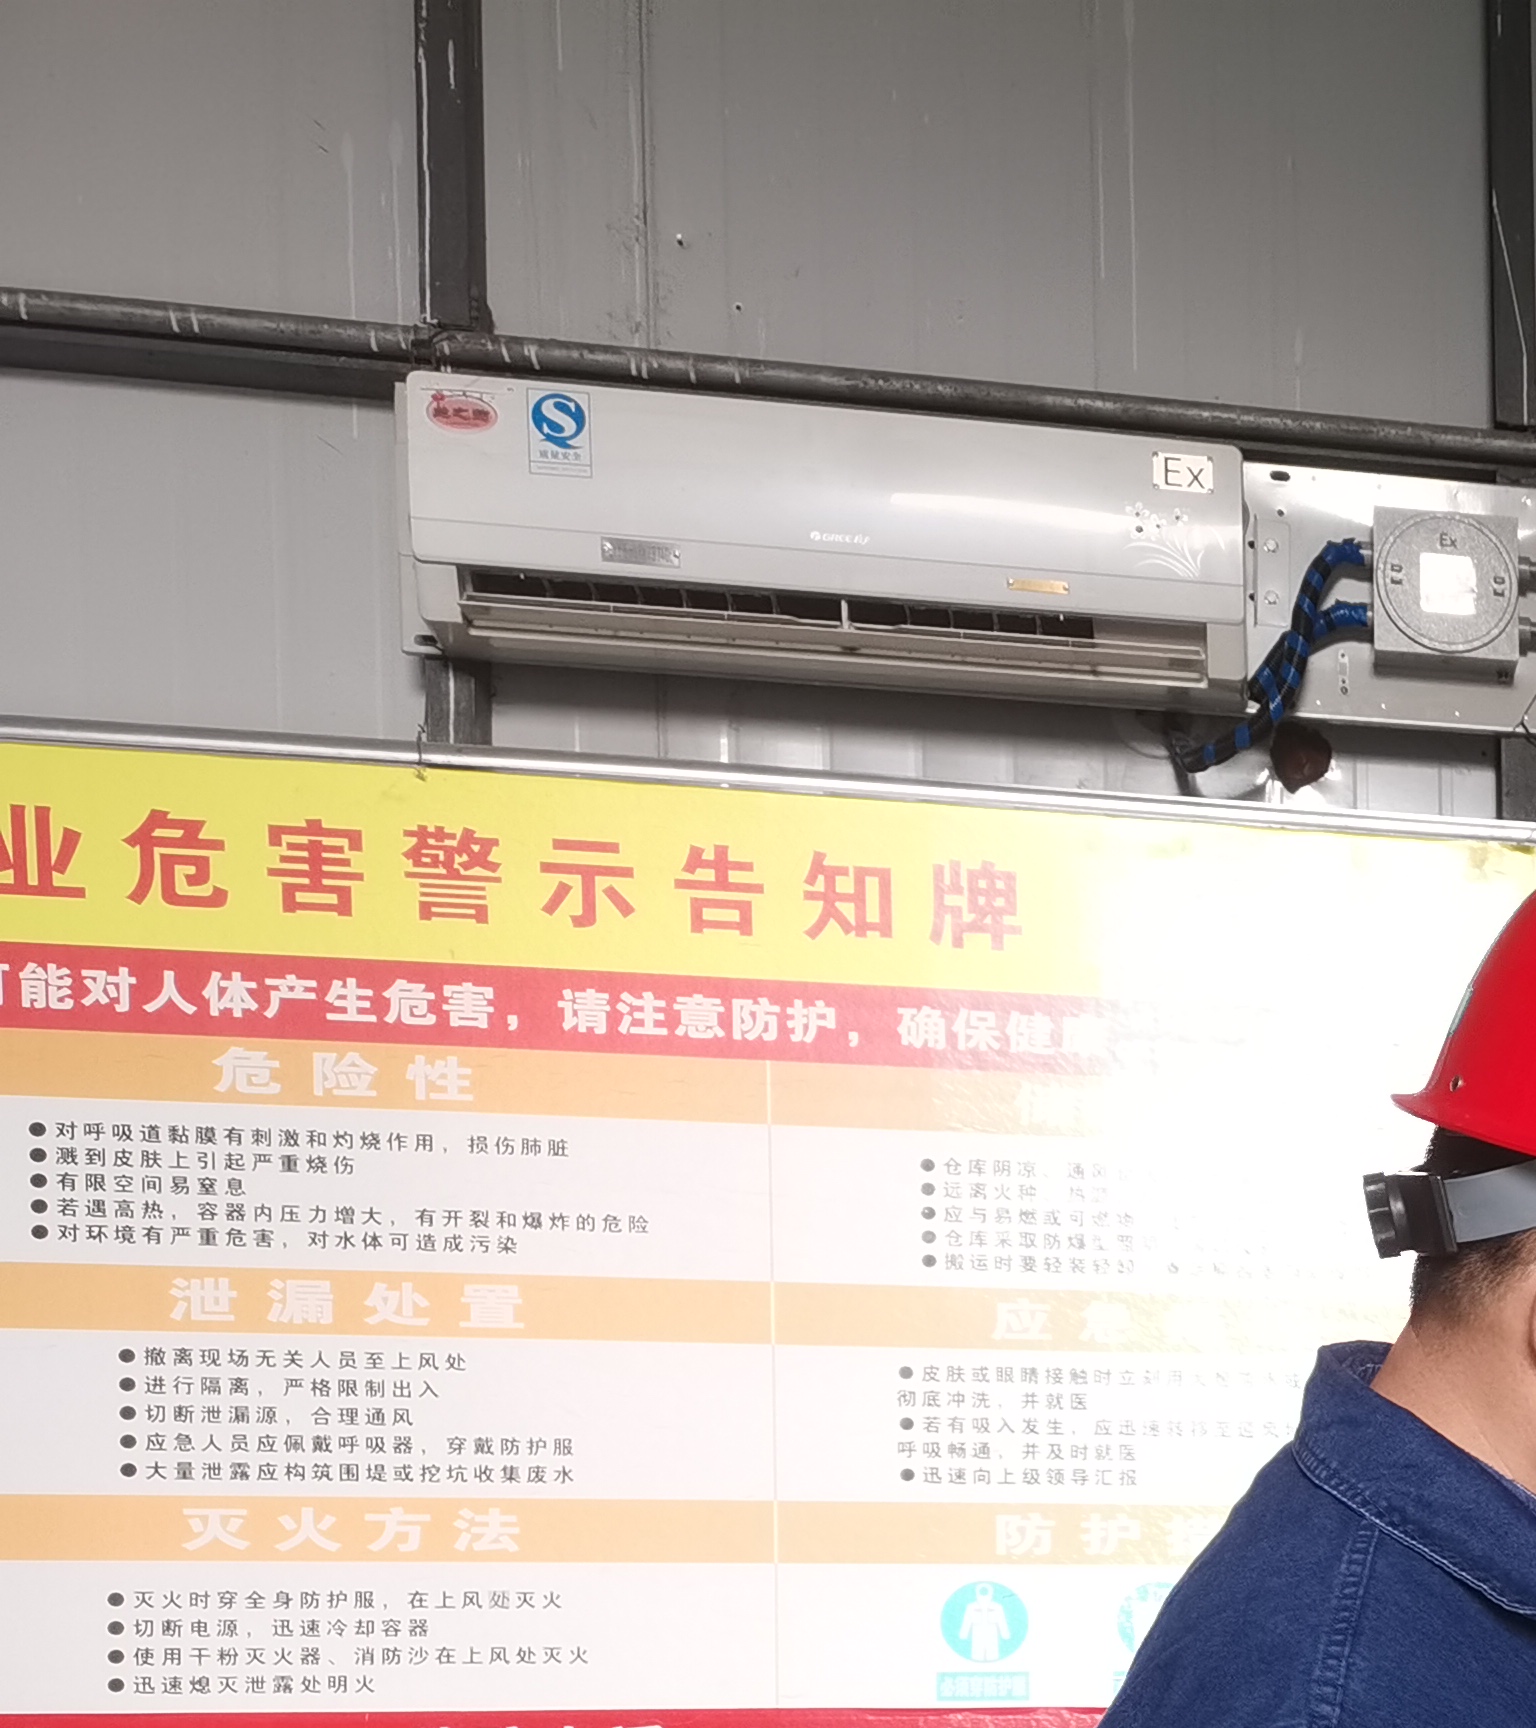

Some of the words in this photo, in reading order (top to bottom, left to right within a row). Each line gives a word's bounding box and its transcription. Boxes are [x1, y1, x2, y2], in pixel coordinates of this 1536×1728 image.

[1163, 456, 1206, 489] Ex
[1439, 531, 1457, 548] Ex
[0, 803, 1022, 951] 业危害警示告知牌
[0, 960, 1107, 1060] 能对人体产生危害，请注意防护，确保健
[212, 1046, 475, 1102] 危险性
[54, 1146, 356, 1176] 溅到皮肤上引起严重烧伤
[55, 1173, 247, 1197] 有限空间易窒息
[57, 1224, 519, 1255] 对环境有严重危害，对水体可造成污染
[169, 1277, 525, 1329] 泄漏处置
[143, 1346, 468, 1372] 撤离现场无关人员至上风处
[144, 1375, 440, 1399] 进行隔离，严格限制出入
[145, 1404, 415, 1428] 切断泄漏源，合理通风
[145, 1432, 575, 1458] 应急人员应佩戴呼吸器，穿戴防护服
[145, 1461, 575, 1485] 大量泄露应构筑围堤或挖坑收集废水
[922, 1467, 1138, 1488] 迅速向上级领导汇报
[181, 1506, 521, 1553] 灭火方法
[132, 1589, 563, 1611] 灭火时穿全身防护服，在上风处灭火
[132, 1617, 430, 1639] 切断电源，迅速冷却容器
[132, 1645, 590, 1668] 使用干粉灭火器、消防沙在上风处灭火
[132, 1674, 377, 1696] 迅速熄灭泄露处明火
